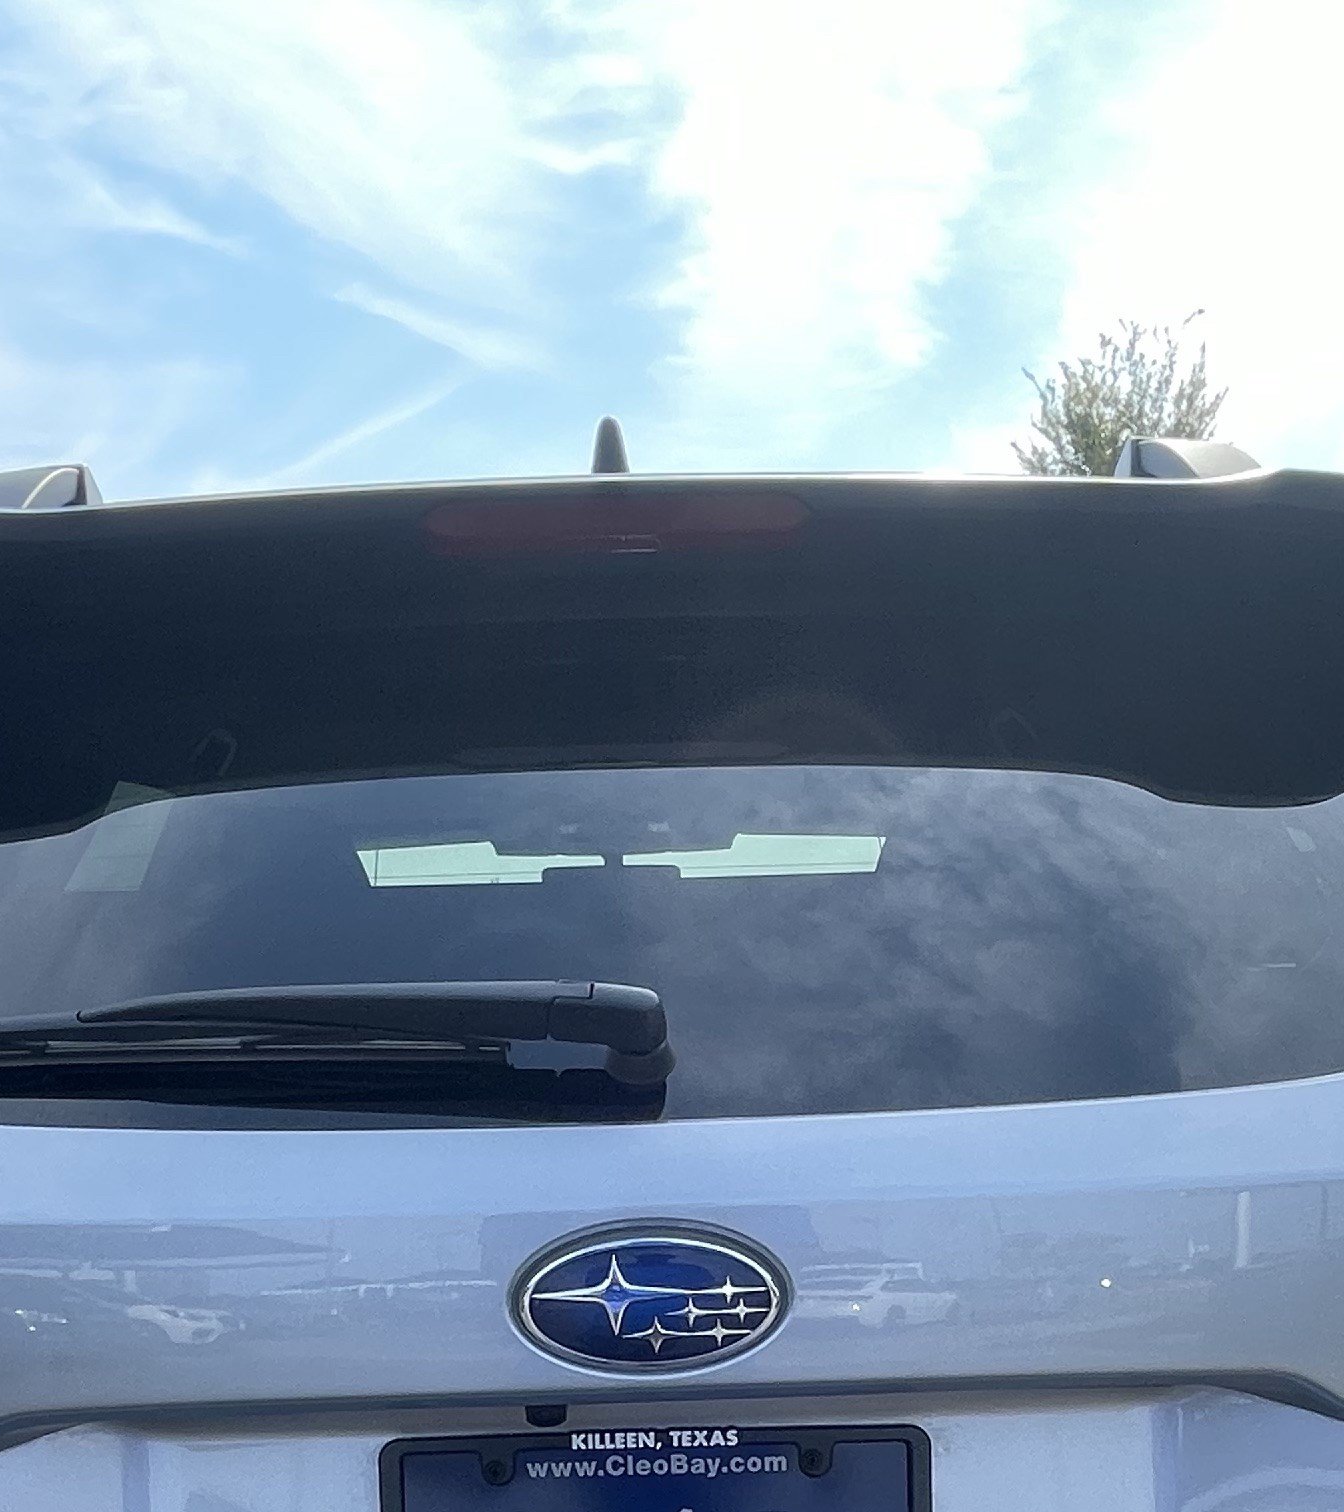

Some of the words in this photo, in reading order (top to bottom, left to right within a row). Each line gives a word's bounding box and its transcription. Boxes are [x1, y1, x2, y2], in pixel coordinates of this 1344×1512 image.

[571, 1432, 663, 1451] KILLEEN,
[669, 1430, 739, 1448] TEXAS
[526, 1453, 788, 1479] www.CleoBay.com
